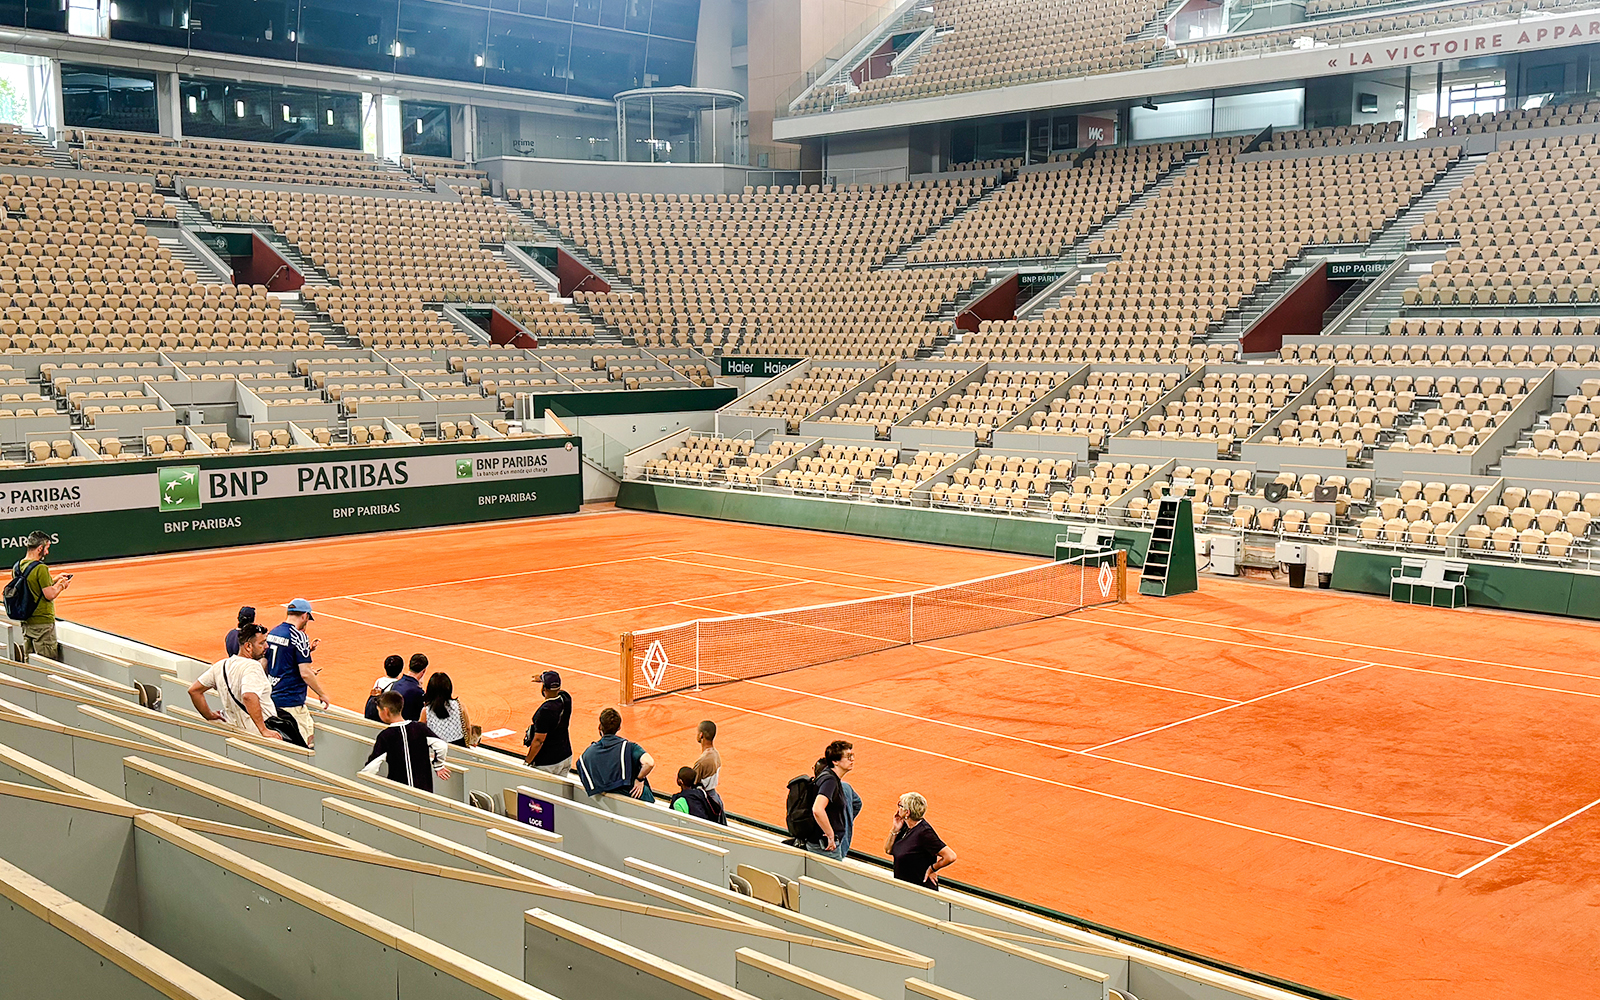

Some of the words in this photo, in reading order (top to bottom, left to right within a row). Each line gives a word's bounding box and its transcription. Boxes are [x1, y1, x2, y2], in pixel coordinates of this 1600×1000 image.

[1349, 52, 1374, 66] LA
[1386, 34, 1503, 61] VICTOIRE
[512, 138, 535, 147] prime
[1332, 264, 1352, 274] BNP
[1021, 275, 1037, 283] BNP
[727, 360, 754, 373] Haier
[632, 424, 637, 433] 5
[476, 458, 500, 471] BNP
[502, 454, 548, 469] PARIBAS
[209, 470, 268, 498] BNP
[297, 460, 409, 492] PARIBAS
[11, 485, 81, 504] PARIBAS
[478, 495, 498, 506] BNP
[499, 491, 537, 504] PARIBAS
[7, 506, 18, 514] for
[26, 503, 59, 512] changing
[60, 501, 81, 509] world
[333, 507, 356, 519] BNP
[357, 503, 401, 517] PARIBAS
[164, 520, 190, 533] BNP
[192, 516, 242, 531] PARIBAS
